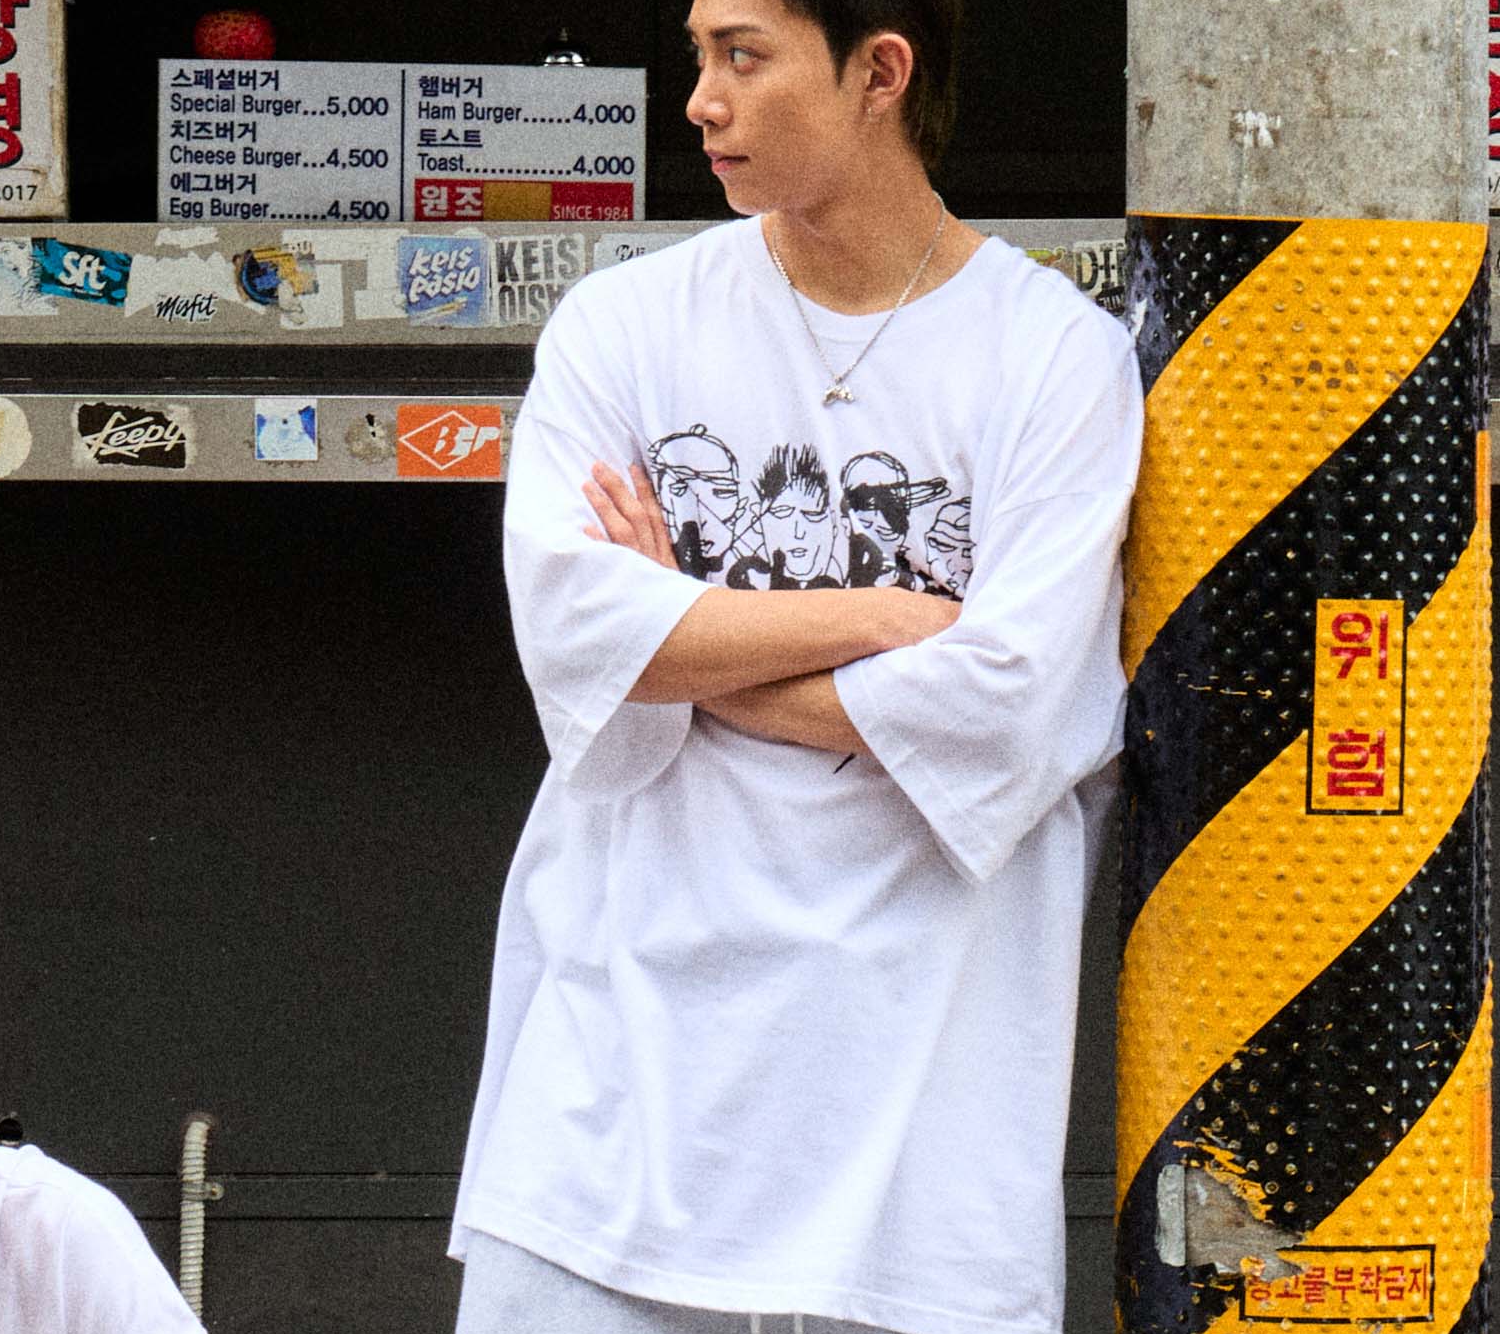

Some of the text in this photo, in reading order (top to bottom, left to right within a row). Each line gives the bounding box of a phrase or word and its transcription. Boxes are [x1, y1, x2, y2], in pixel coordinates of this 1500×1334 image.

[170, 68, 279, 91] 스페셜버거
[418, 75, 483, 98] 햄버거
[170, 93, 235, 115] Special
[418, 101, 456, 121] Ham
[170, 120, 257, 143] 치즈버거
[417, 128, 483, 147] 토스트
[170, 145, 236, 165] Cheese
[170, 172, 257, 194] 에그버거
[170, 197, 203, 218] Egg
[553, 205, 592, 220] SINCE
[597, 206, 628, 221] 1984
[1327, 612, 1388, 796] 위험
